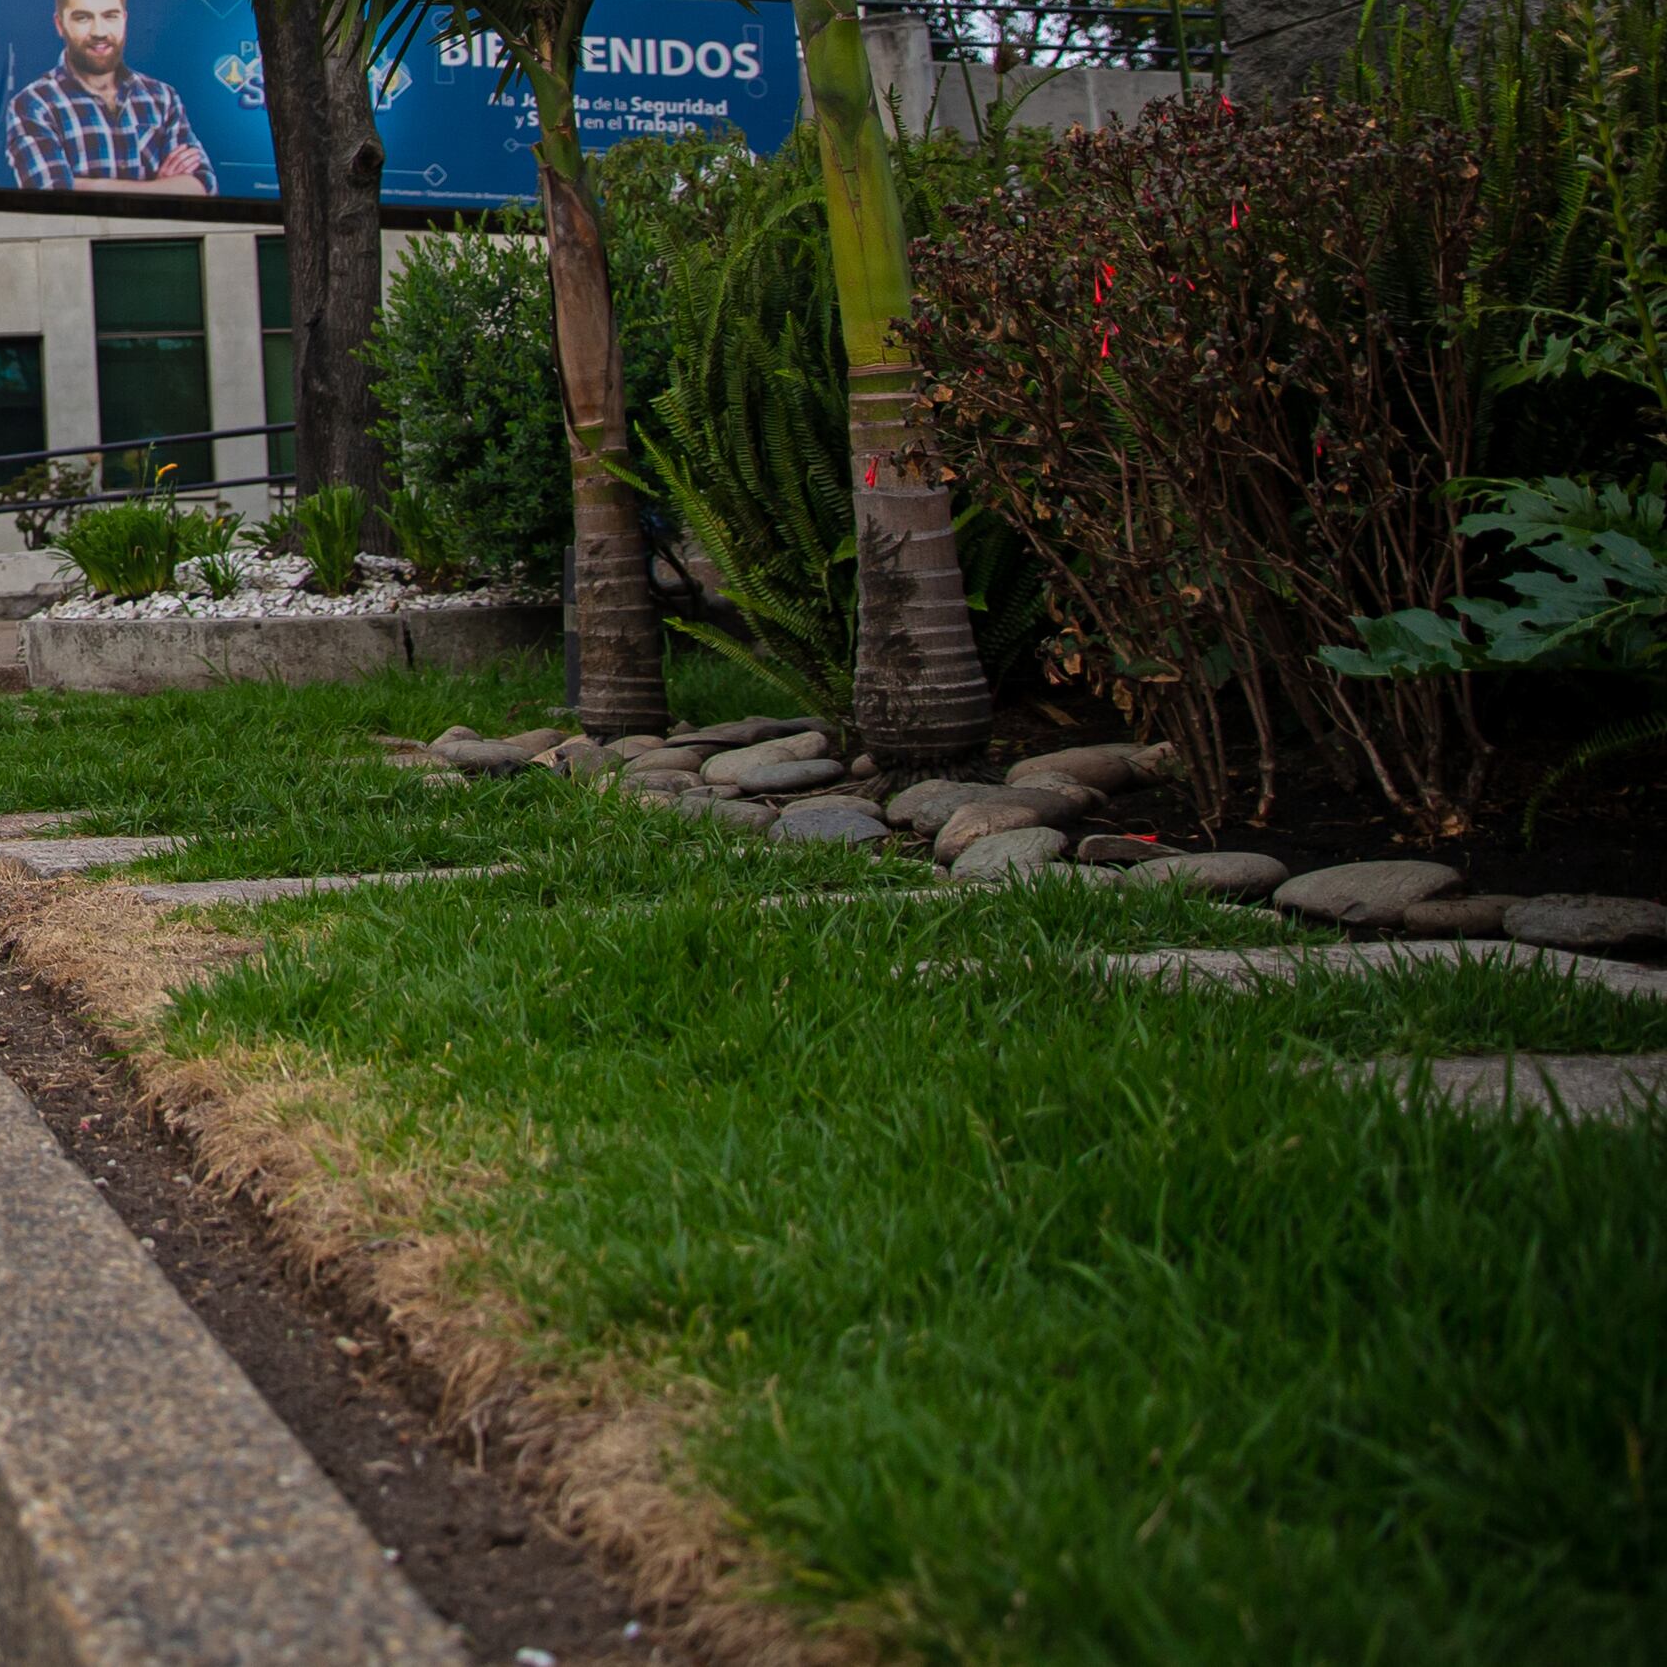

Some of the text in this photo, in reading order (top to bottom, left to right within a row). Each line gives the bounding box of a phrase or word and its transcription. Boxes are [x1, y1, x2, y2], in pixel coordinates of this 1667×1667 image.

[439, 30, 761, 80] BIEENIDOS
[501, 92, 515, 107] la
[592, 97, 612, 111] de
[614, 98, 628, 112] la
[630, 96, 727, 117] Seguridad
[515, 115, 525, 129] y
[583, 117, 604, 129] en
[607, 116, 623, 131] el
[624, 115, 697, 135] Trabajo
